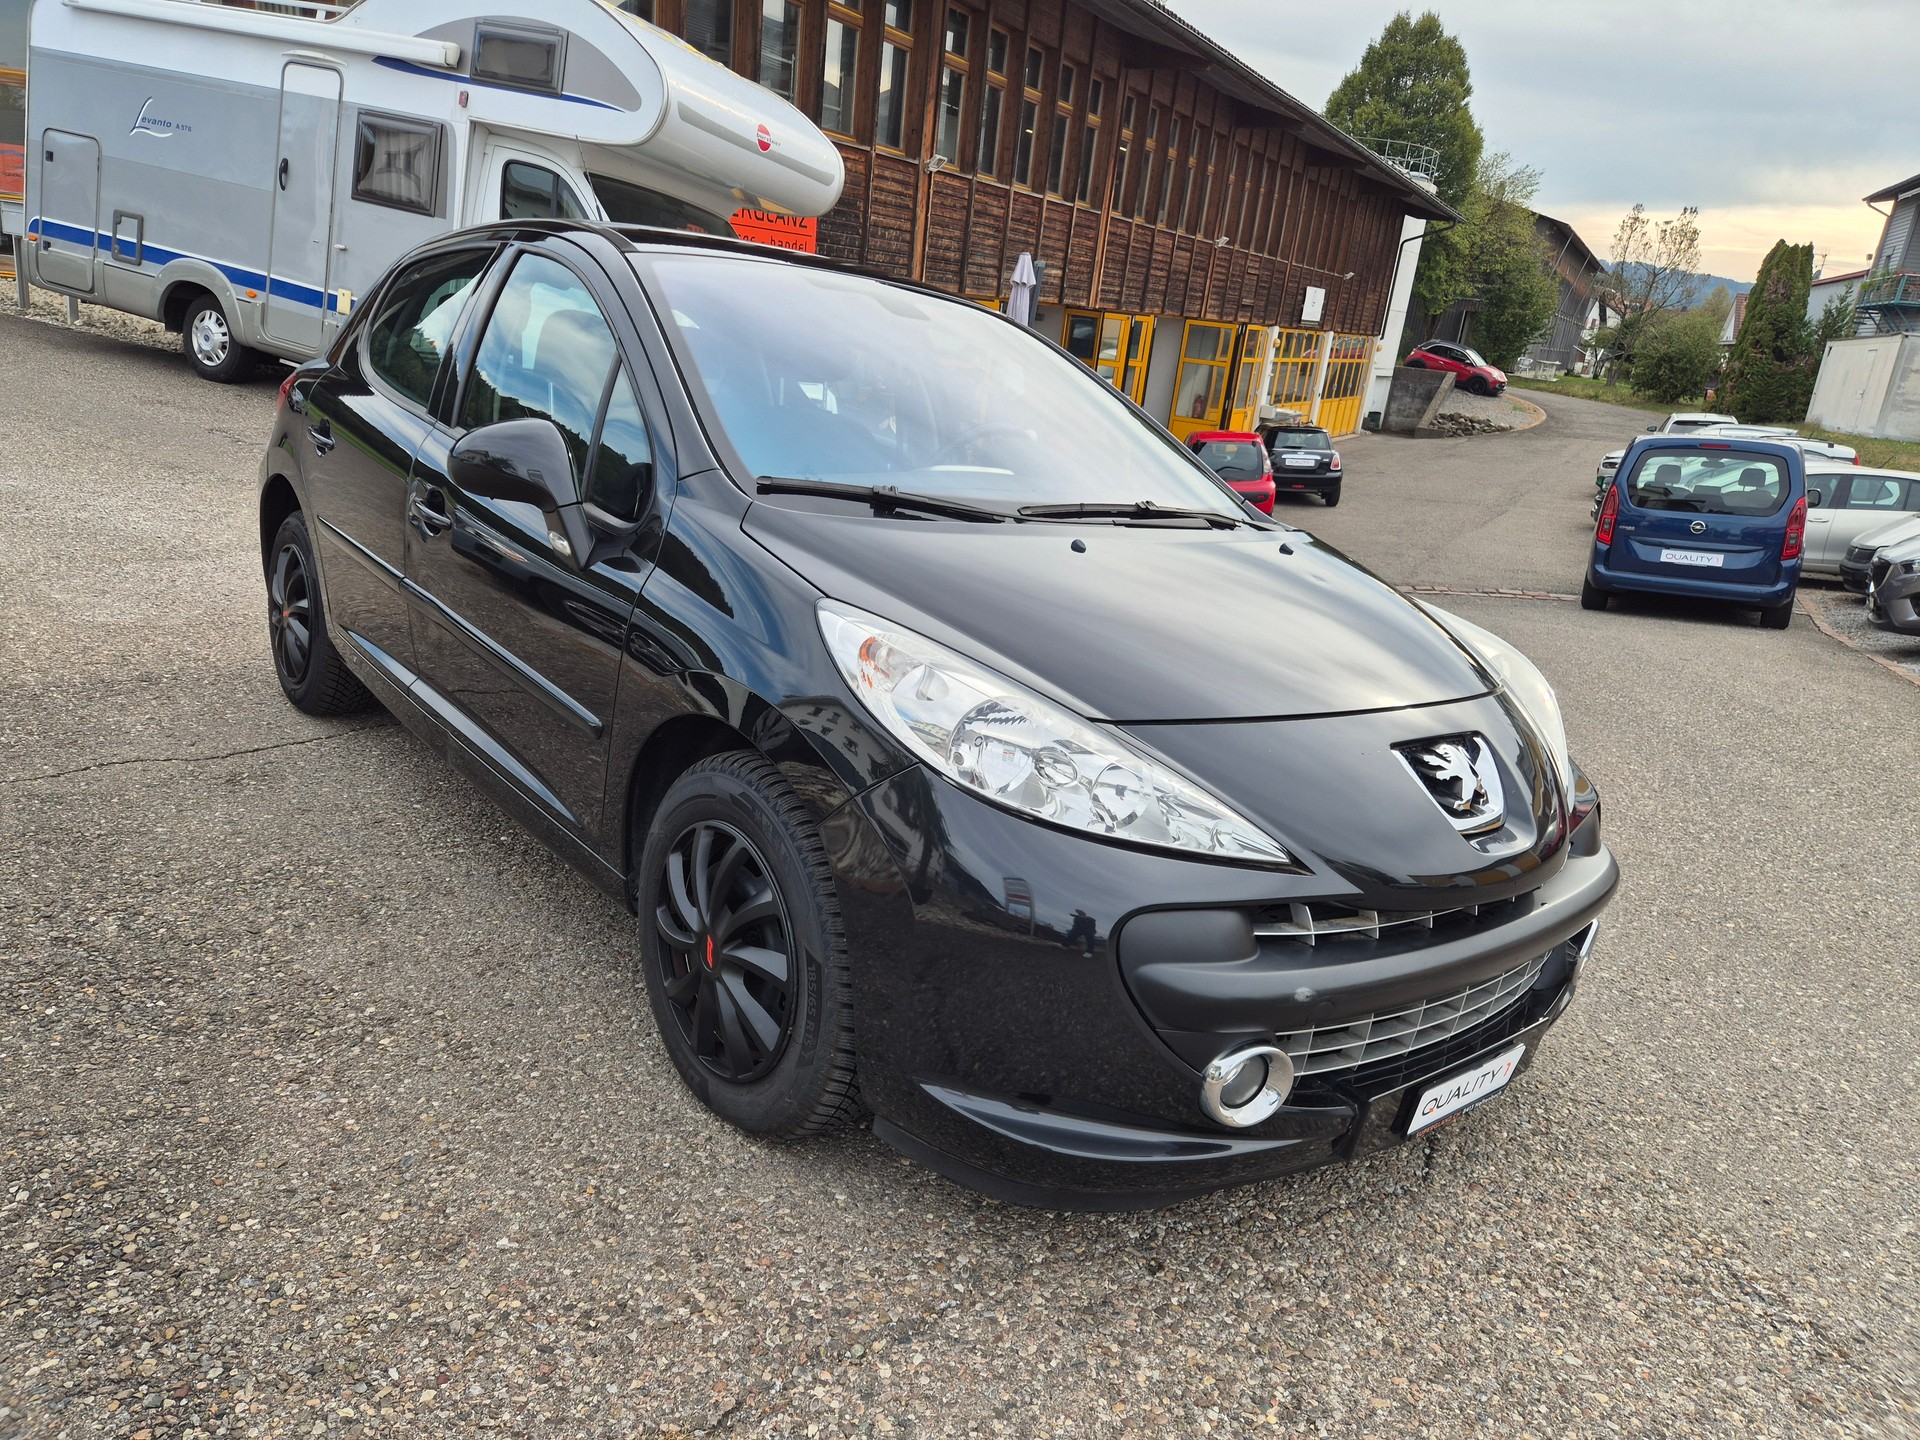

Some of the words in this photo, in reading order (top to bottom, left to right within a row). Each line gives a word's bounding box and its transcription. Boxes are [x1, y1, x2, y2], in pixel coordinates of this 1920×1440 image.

[129, 96, 173, 137] Levanto
[1665, 553, 1713, 563] QUALITY
[807, 964, 817, 1017] 185/65
[1422, 1065, 1503, 1116] QUALITY
[1503, 1062, 1512, 1077] 1
